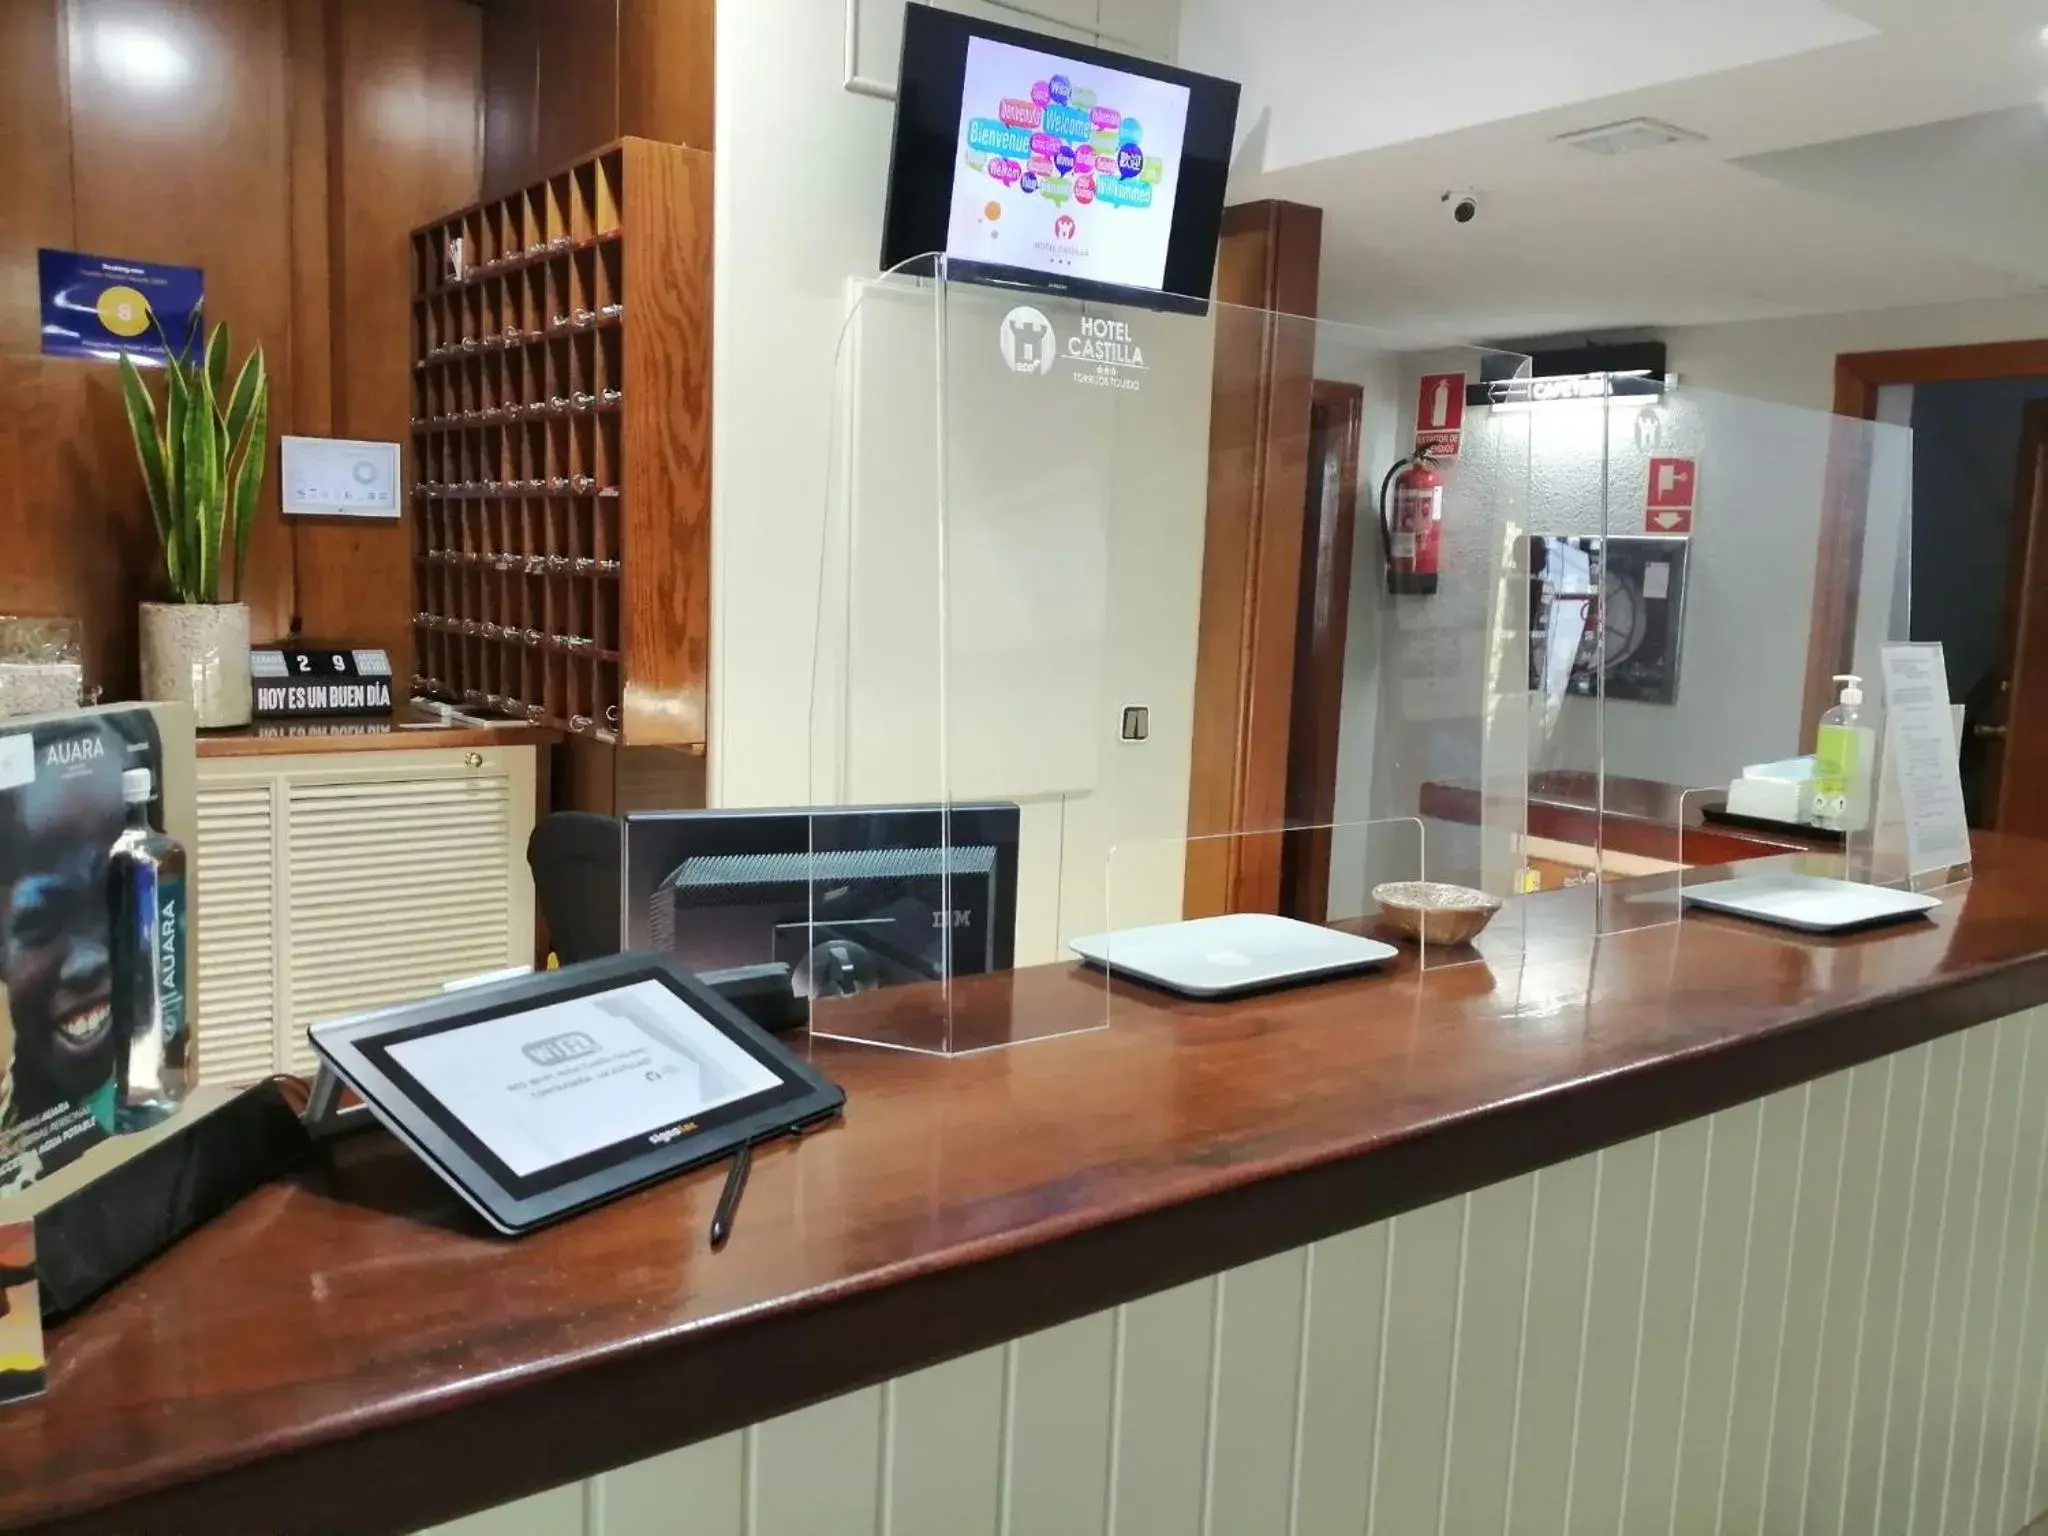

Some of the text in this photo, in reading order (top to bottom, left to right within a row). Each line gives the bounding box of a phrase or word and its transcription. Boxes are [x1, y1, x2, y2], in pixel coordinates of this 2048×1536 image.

[969, 120, 1030, 152] Bienvenue
[1045, 109, 1090, 137] Welcome
[1081, 317, 1132, 343] HOTEL
[1068, 337, 1145, 366] CASTILLA
[296, 654, 311, 672] 2
[332, 654, 346, 672] 9
[257, 680, 391, 711] HOY ES UN BUEN DÍA
[46, 736, 104, 767] AUARA
[161, 899, 176, 988] AUARA
